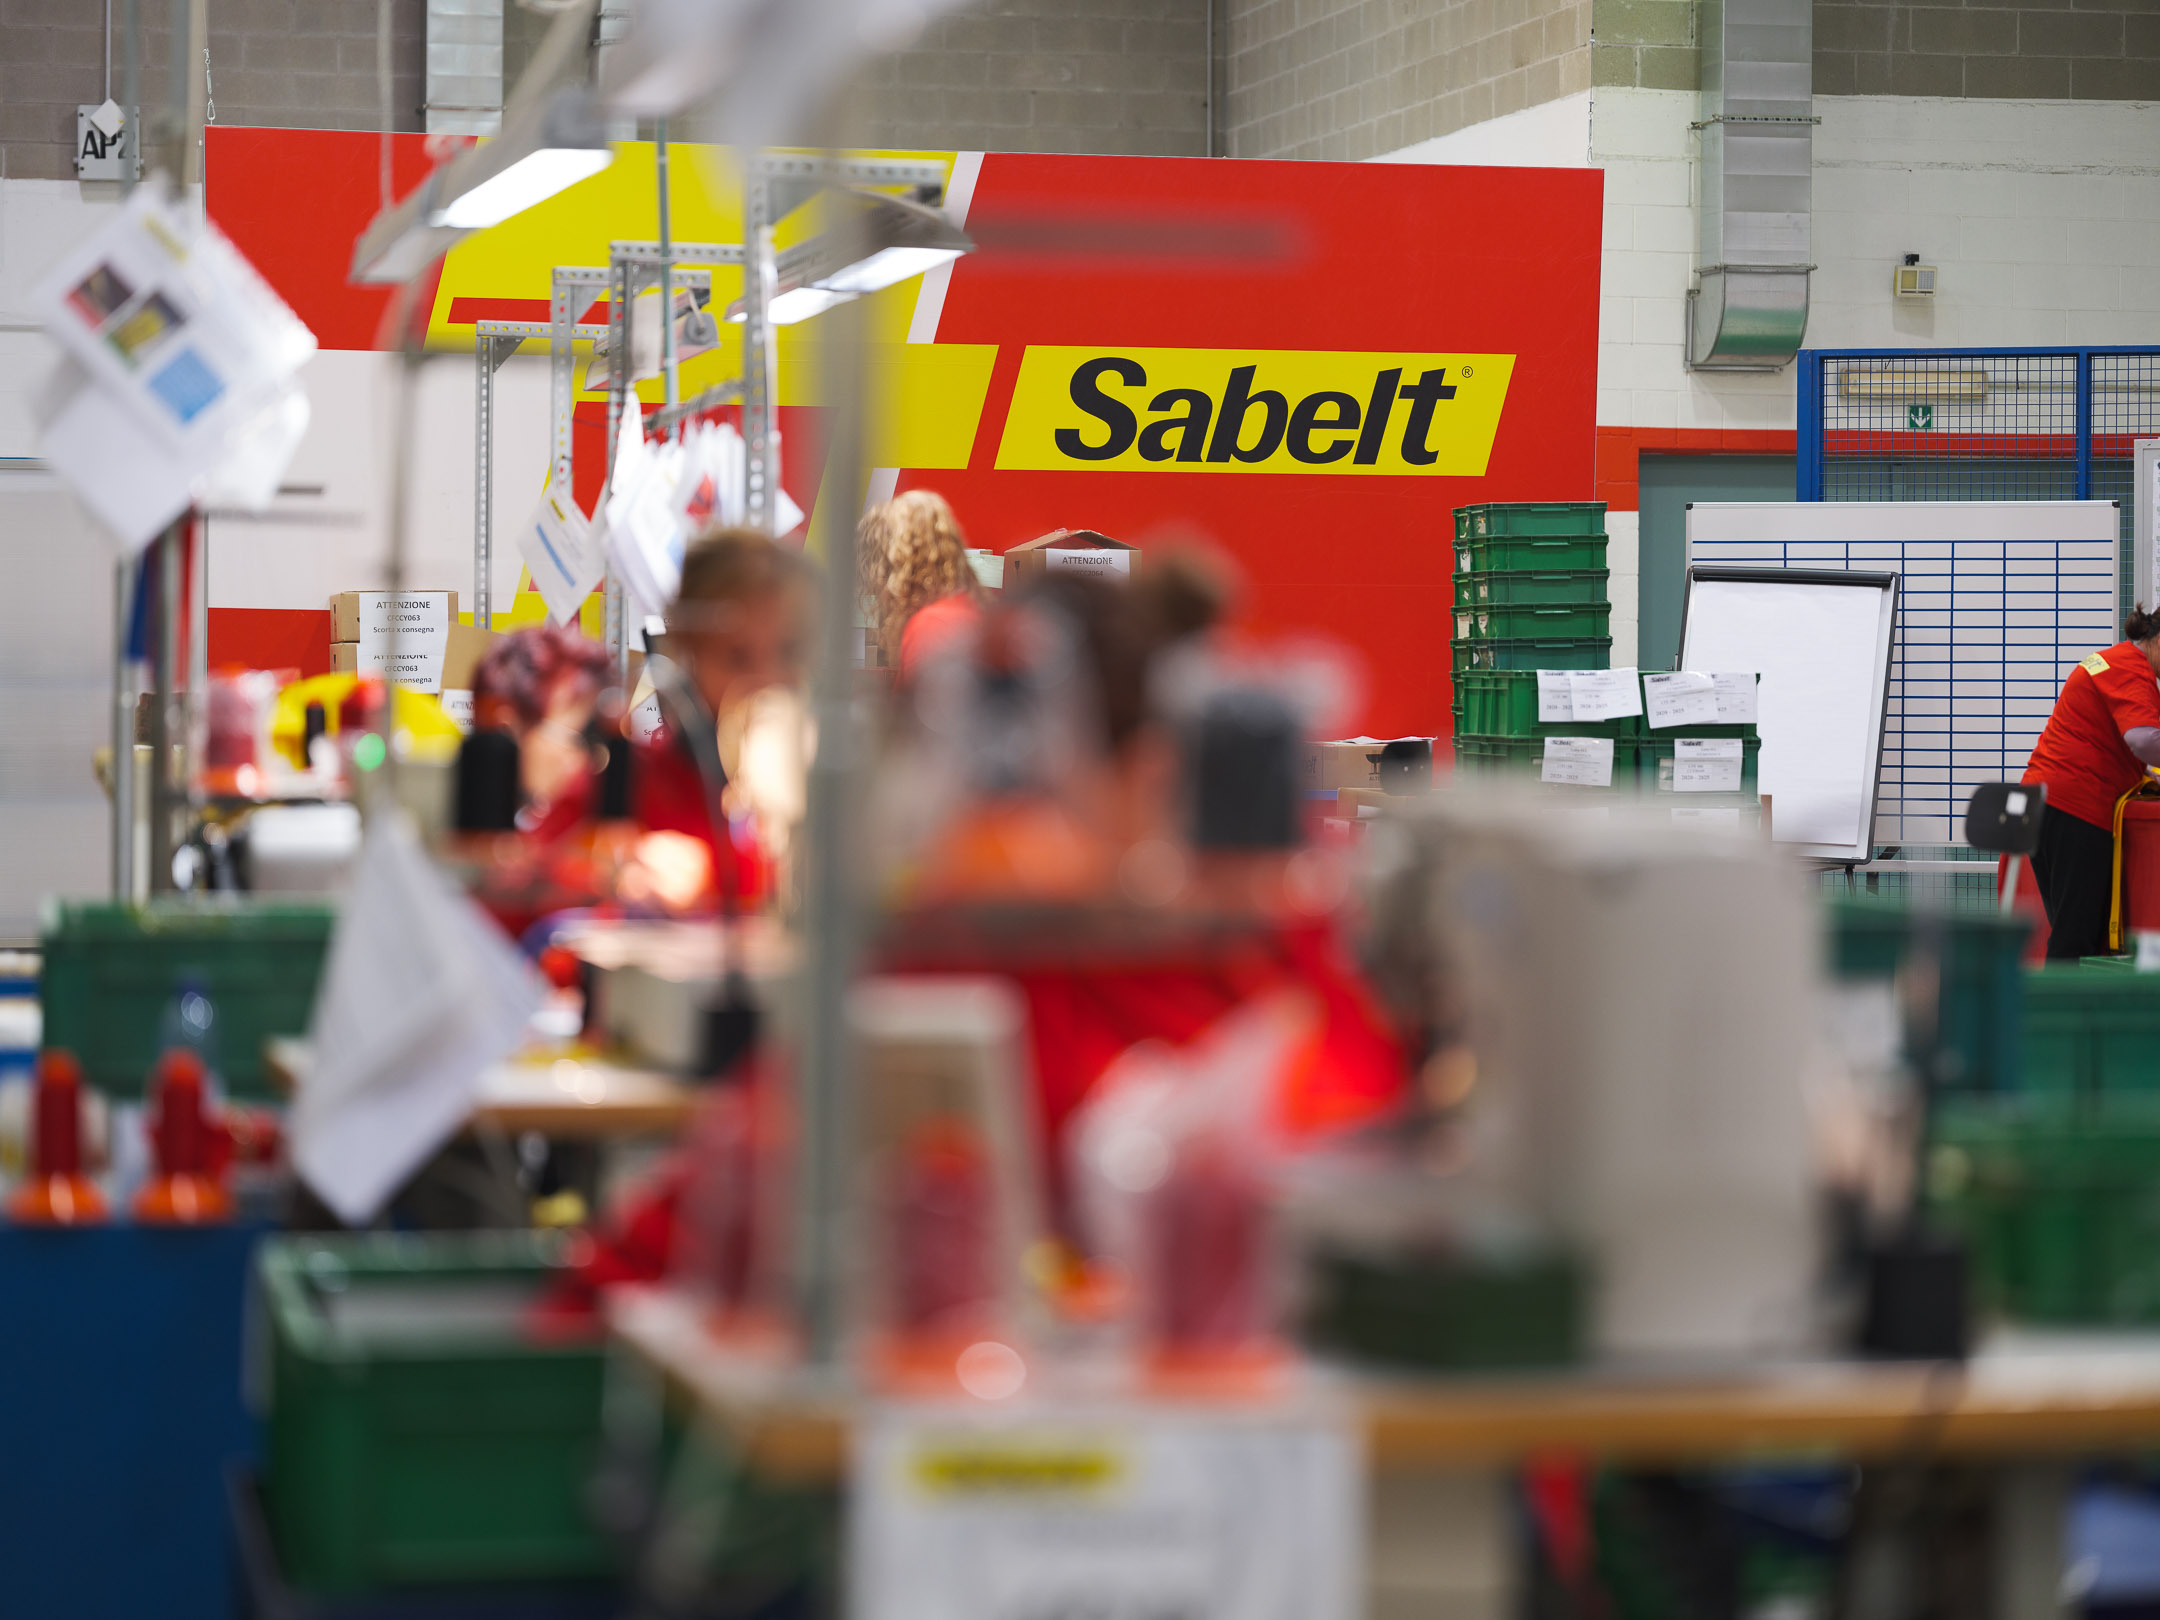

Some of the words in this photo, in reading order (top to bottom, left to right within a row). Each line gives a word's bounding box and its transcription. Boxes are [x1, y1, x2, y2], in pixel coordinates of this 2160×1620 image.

[1054, 357, 1457, 466] Sabelt
[1062, 556, 1113, 565] ATTENZIONE
[376, 601, 431, 609] ATTENZIONE
[400, 677, 433, 685] consegna
